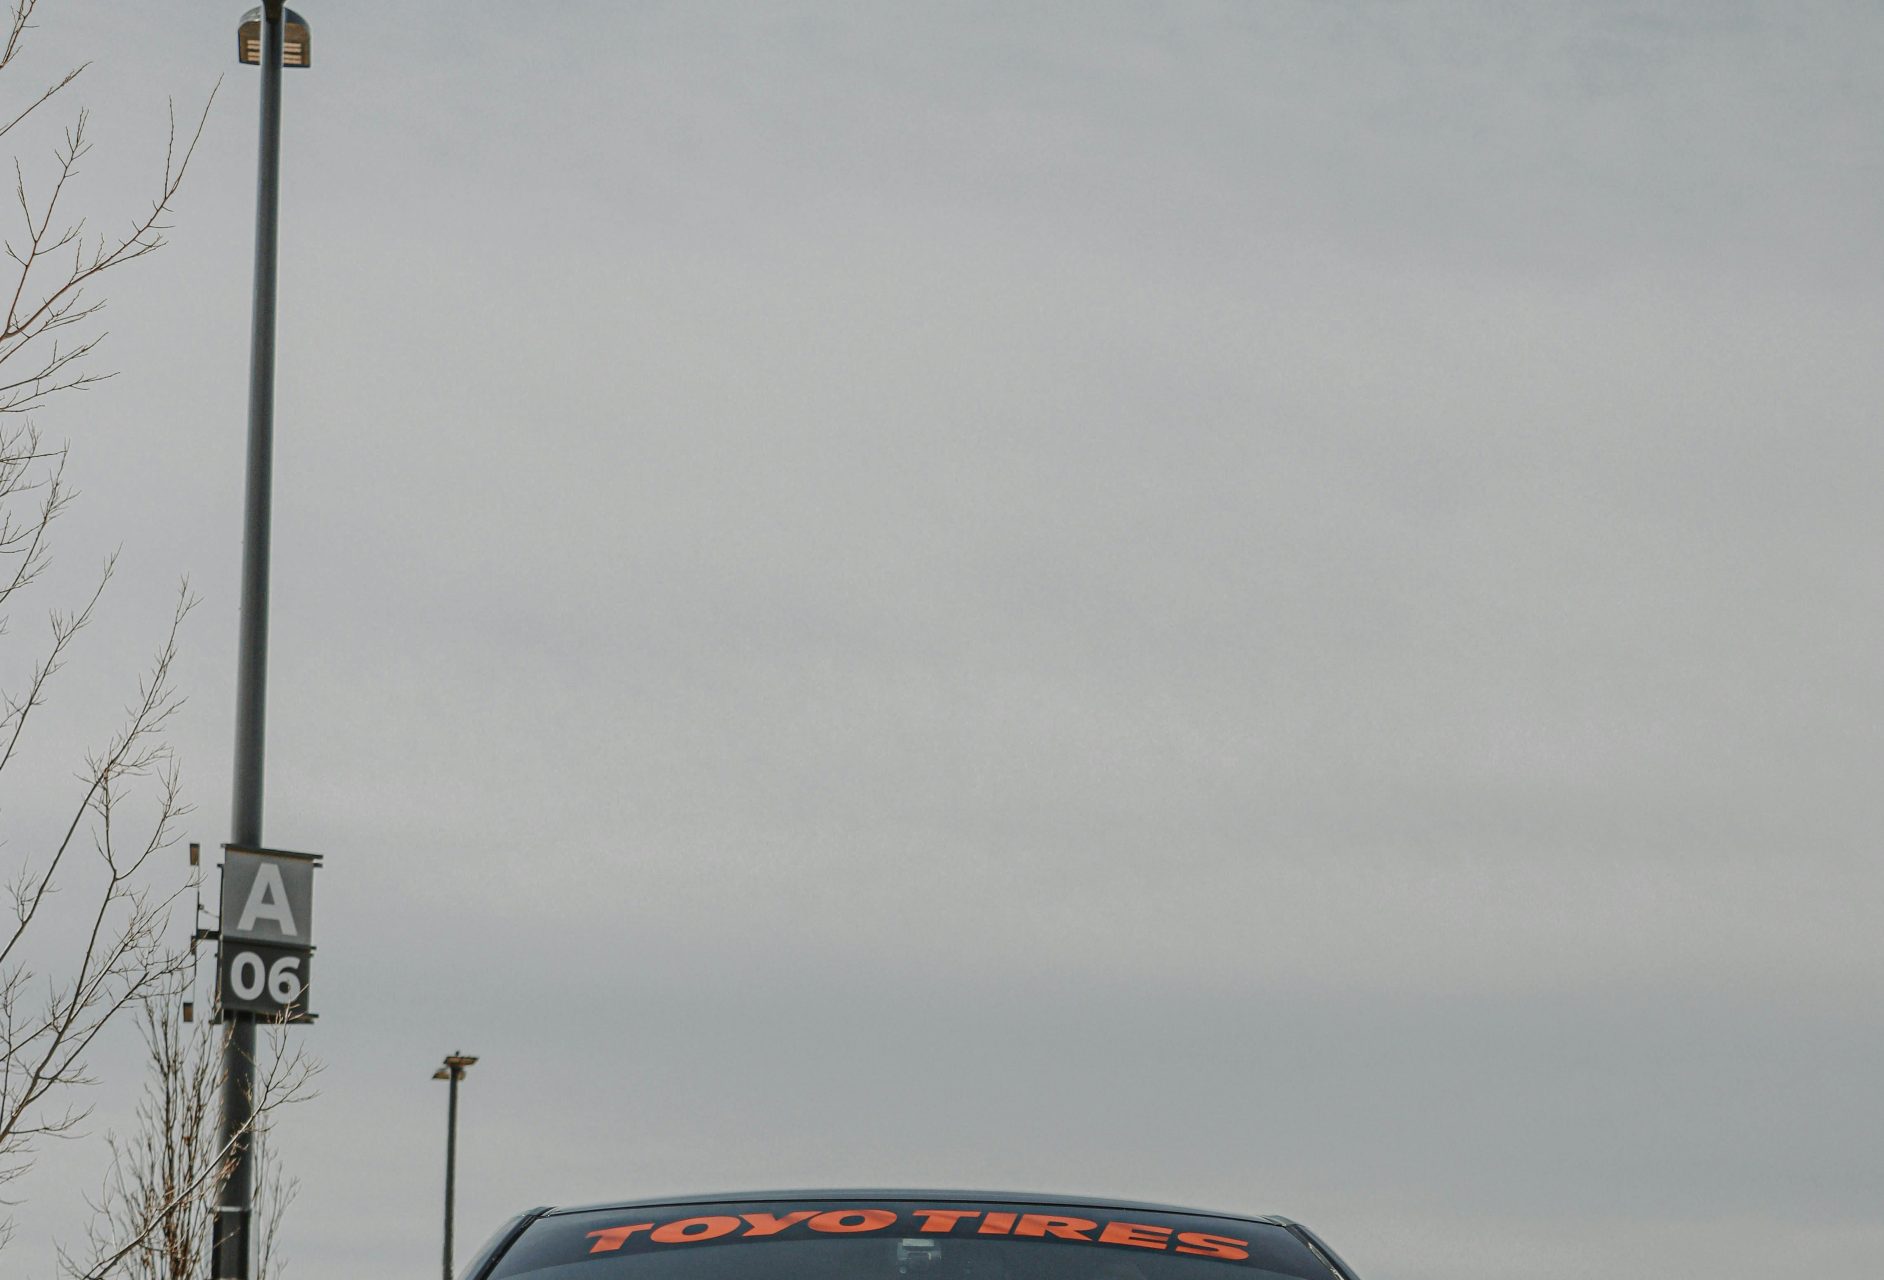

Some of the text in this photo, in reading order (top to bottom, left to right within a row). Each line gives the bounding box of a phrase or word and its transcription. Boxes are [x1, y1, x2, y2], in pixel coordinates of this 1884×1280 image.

[237, 862, 298, 936] A
[230, 951, 301, 1004] 06
[586, 1209, 1249, 1260] TOYO TIRES
